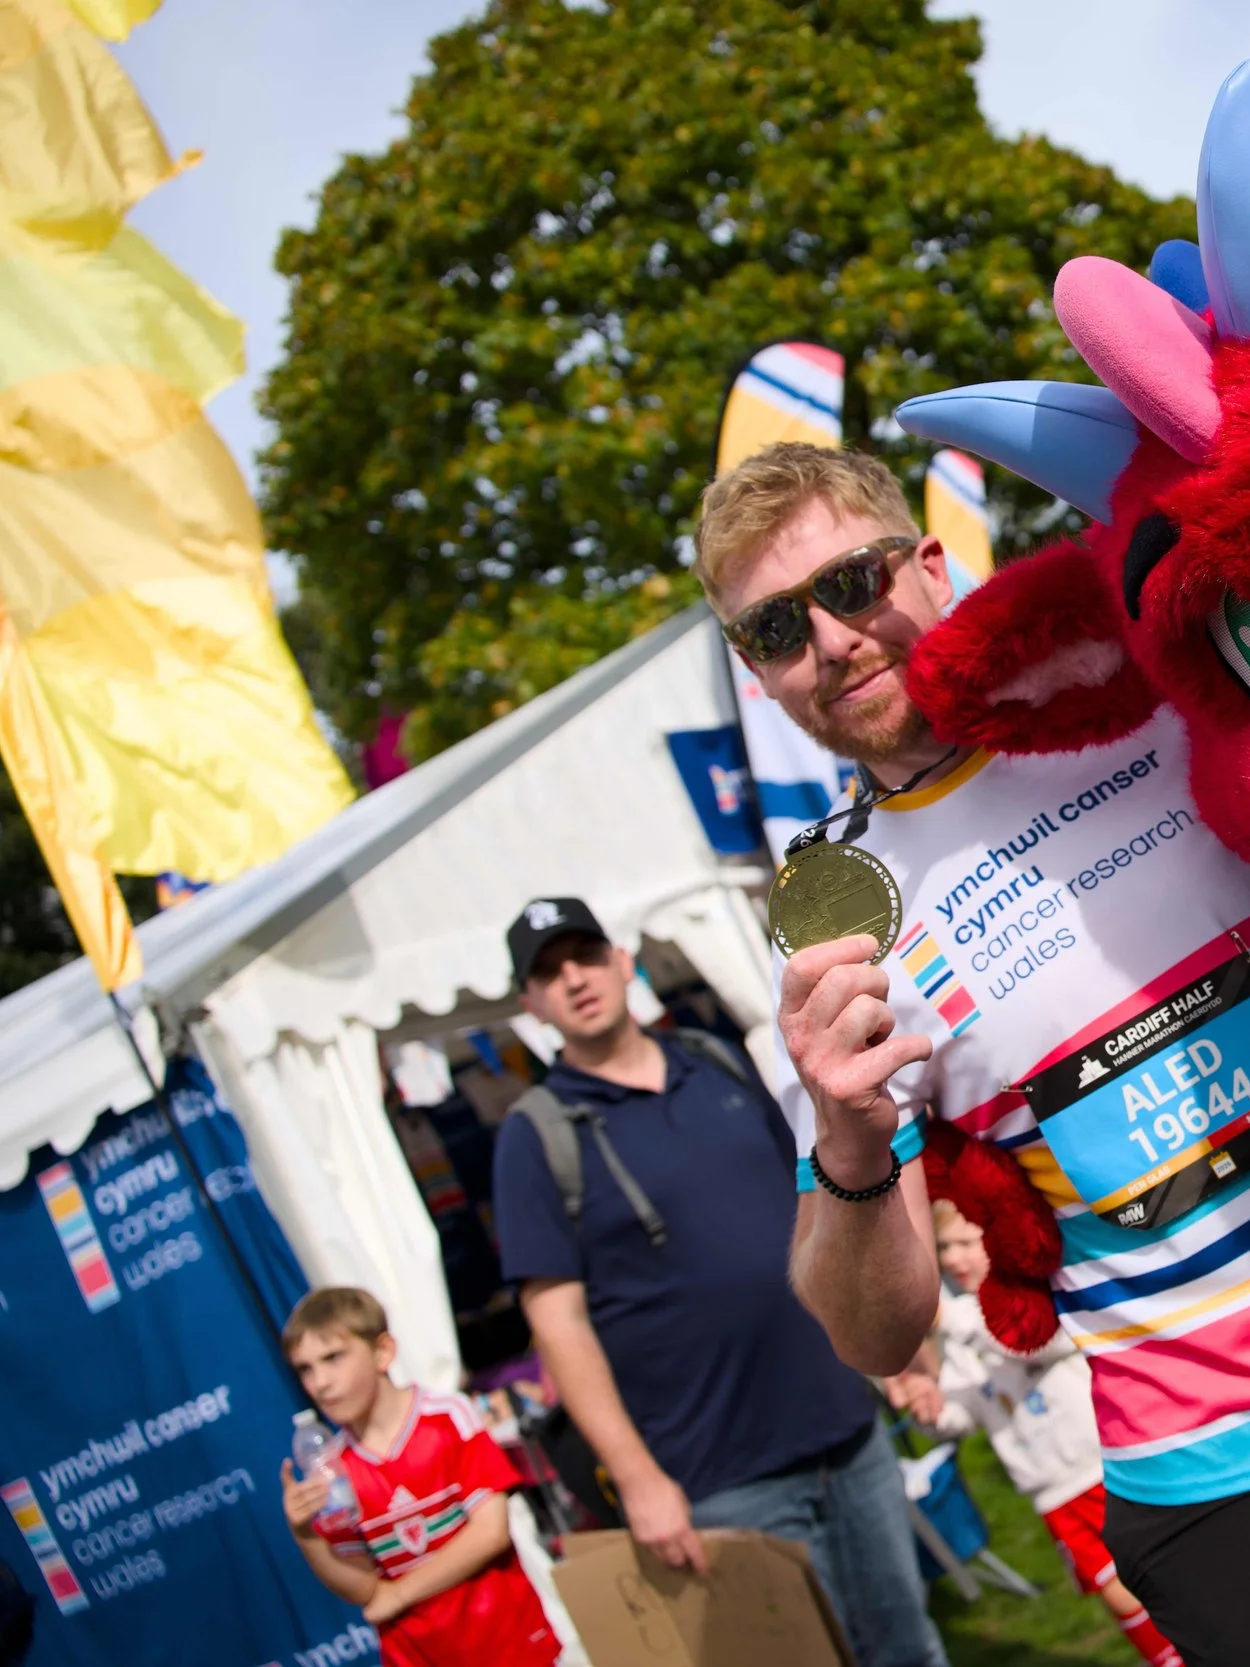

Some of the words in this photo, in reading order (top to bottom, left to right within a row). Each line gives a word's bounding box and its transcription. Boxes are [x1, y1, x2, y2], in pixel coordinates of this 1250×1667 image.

[935, 812, 1060, 925] ymchwil
[1058, 750, 1160, 822] canser
[954, 865, 1045, 945] cymru
[971, 888, 1065, 972] cancer
[1066, 809, 1194, 899] research
[989, 927, 1076, 1000] wales
[1104, 1006, 1171, 1056] CARDIFF
[1172, 980, 1214, 1016] HALF
[1113, 1043, 1145, 1067] HANNER
[1143, 1020, 1185, 1048] MARATHON
[1184, 996, 1222, 1023] CAERDYDD
[1121, 1038, 1223, 1123] ALED
[94, 1150, 179, 1215] cymru
[108, 1186, 195, 1253] cancer
[122, 1231, 203, 1291] wales
[39, 1419, 150, 1503] ymchwil
[144, 1384, 231, 1448] canser
[55, 1473, 140, 1532] cymru
[71, 1508, 155, 1566] cancer
[89, 1548, 167, 1600] wales
